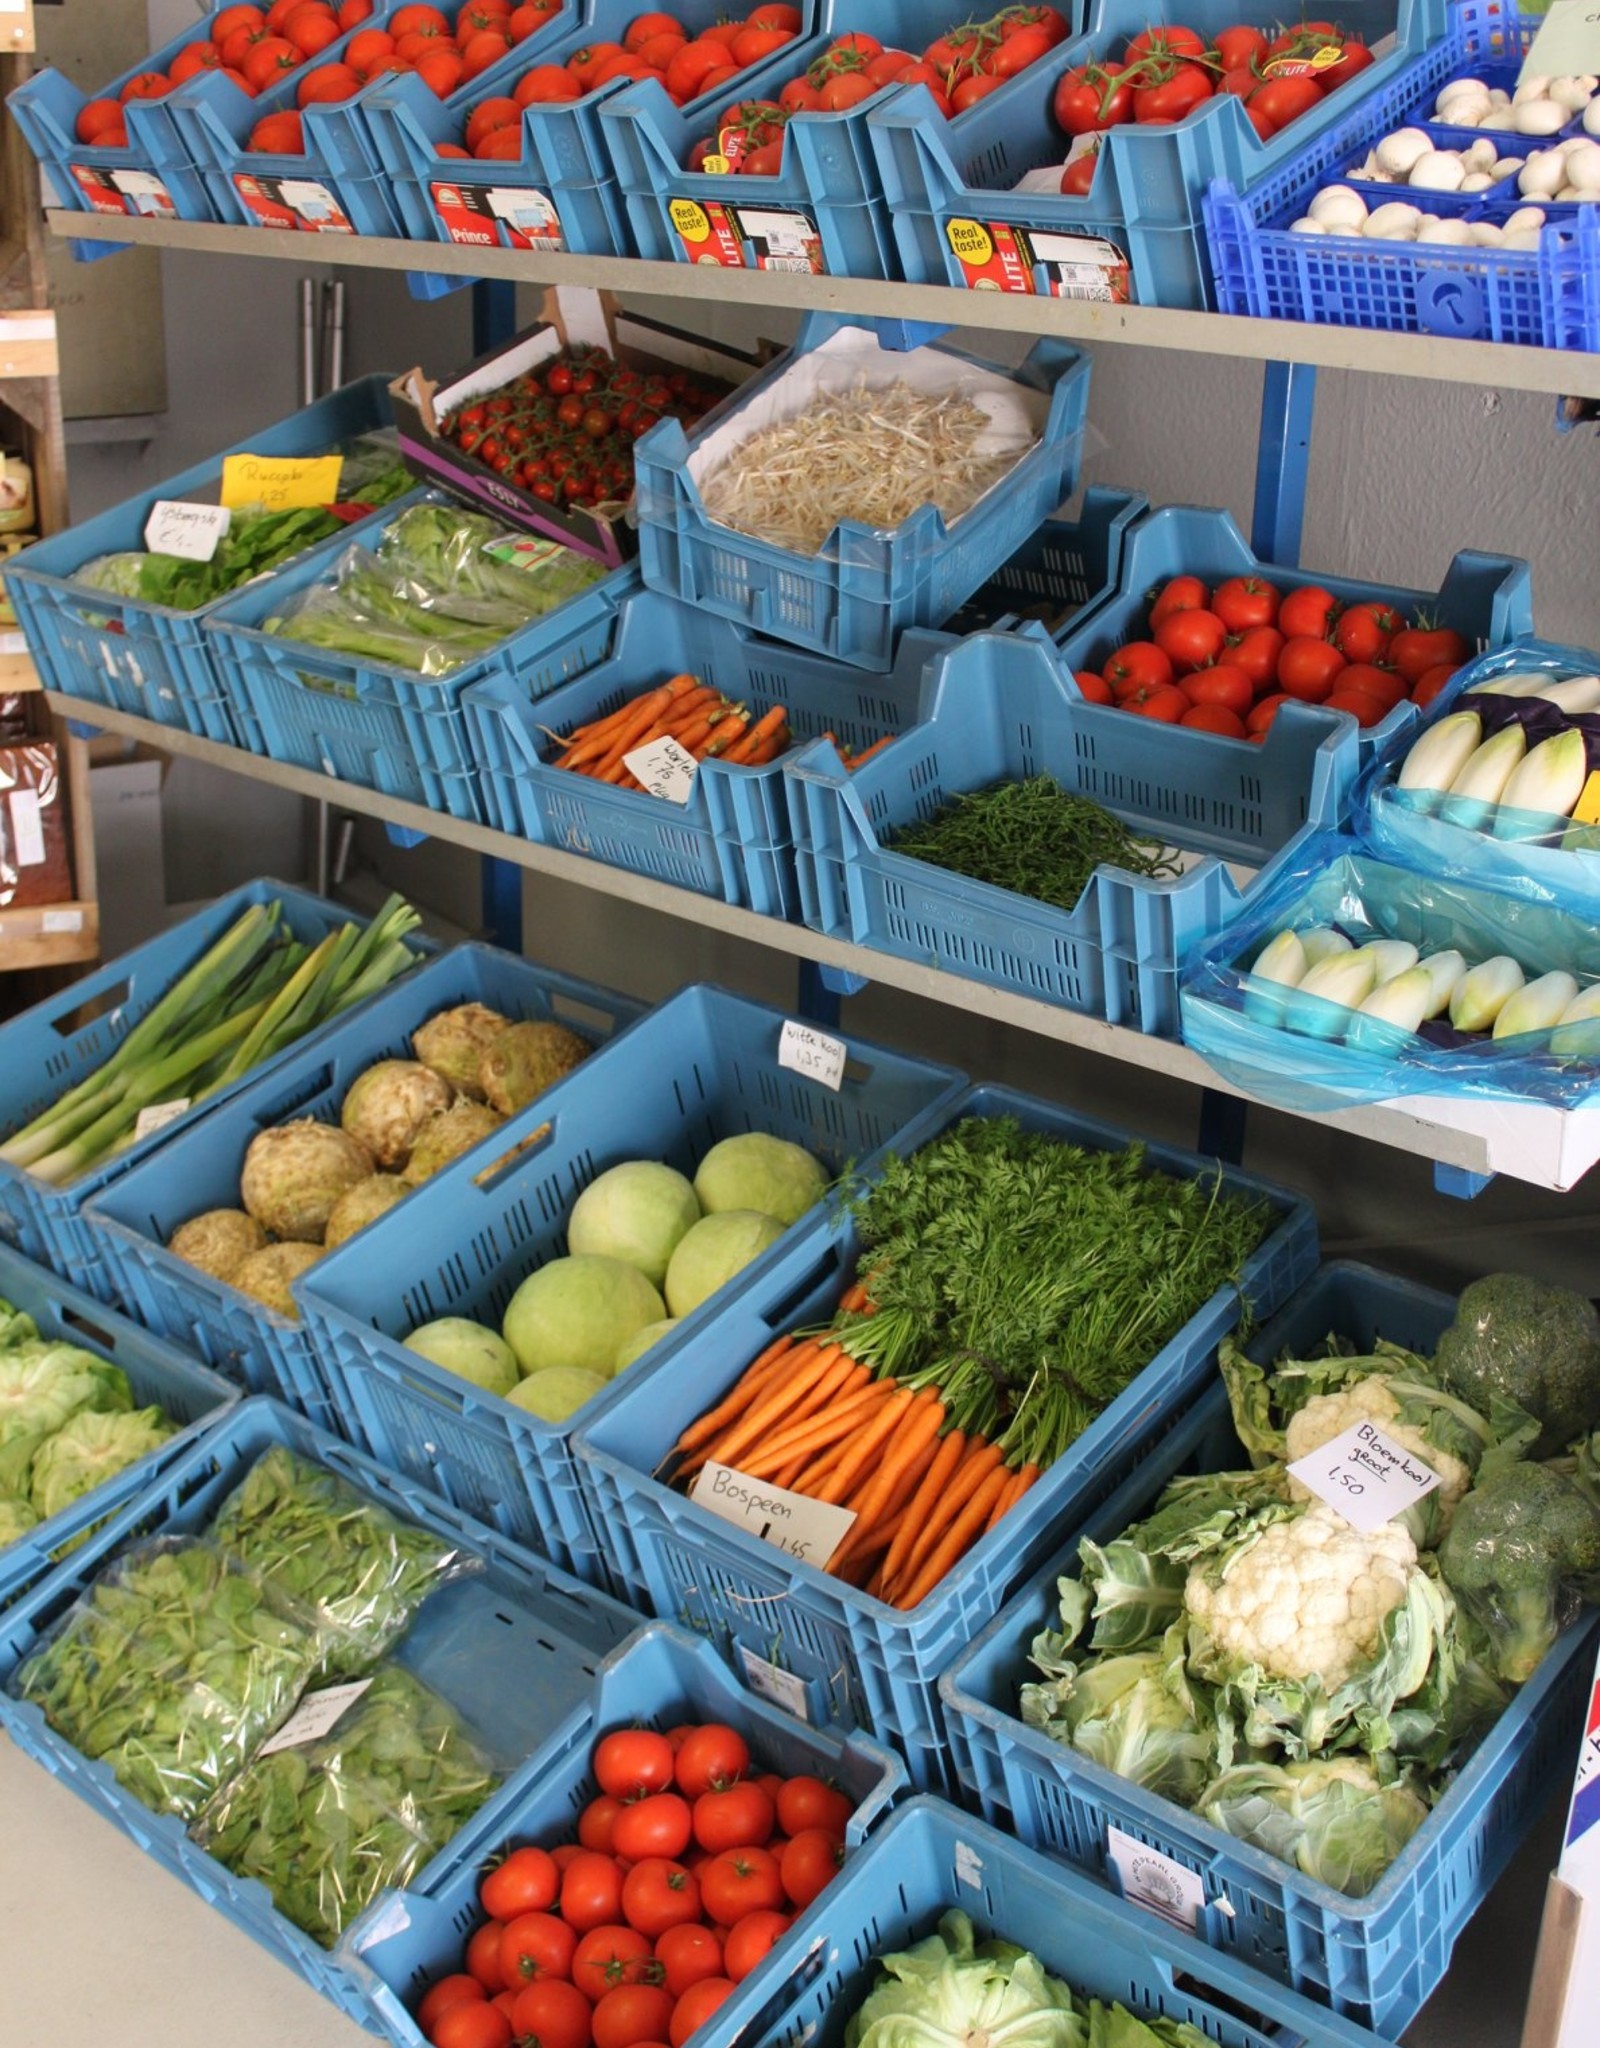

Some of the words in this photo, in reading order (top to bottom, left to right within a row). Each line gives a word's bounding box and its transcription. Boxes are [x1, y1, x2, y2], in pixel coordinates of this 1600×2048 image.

[674, 204, 697, 219] Real
[677, 215, 706, 232] taste!
[450, 227, 492, 245] Prince
[951, 225, 978, 240] Real
[954, 237, 989, 253] taste!
[1328, 1466, 1365, 1495] 1,50
[712, 1470, 792, 1520] Bospeen
